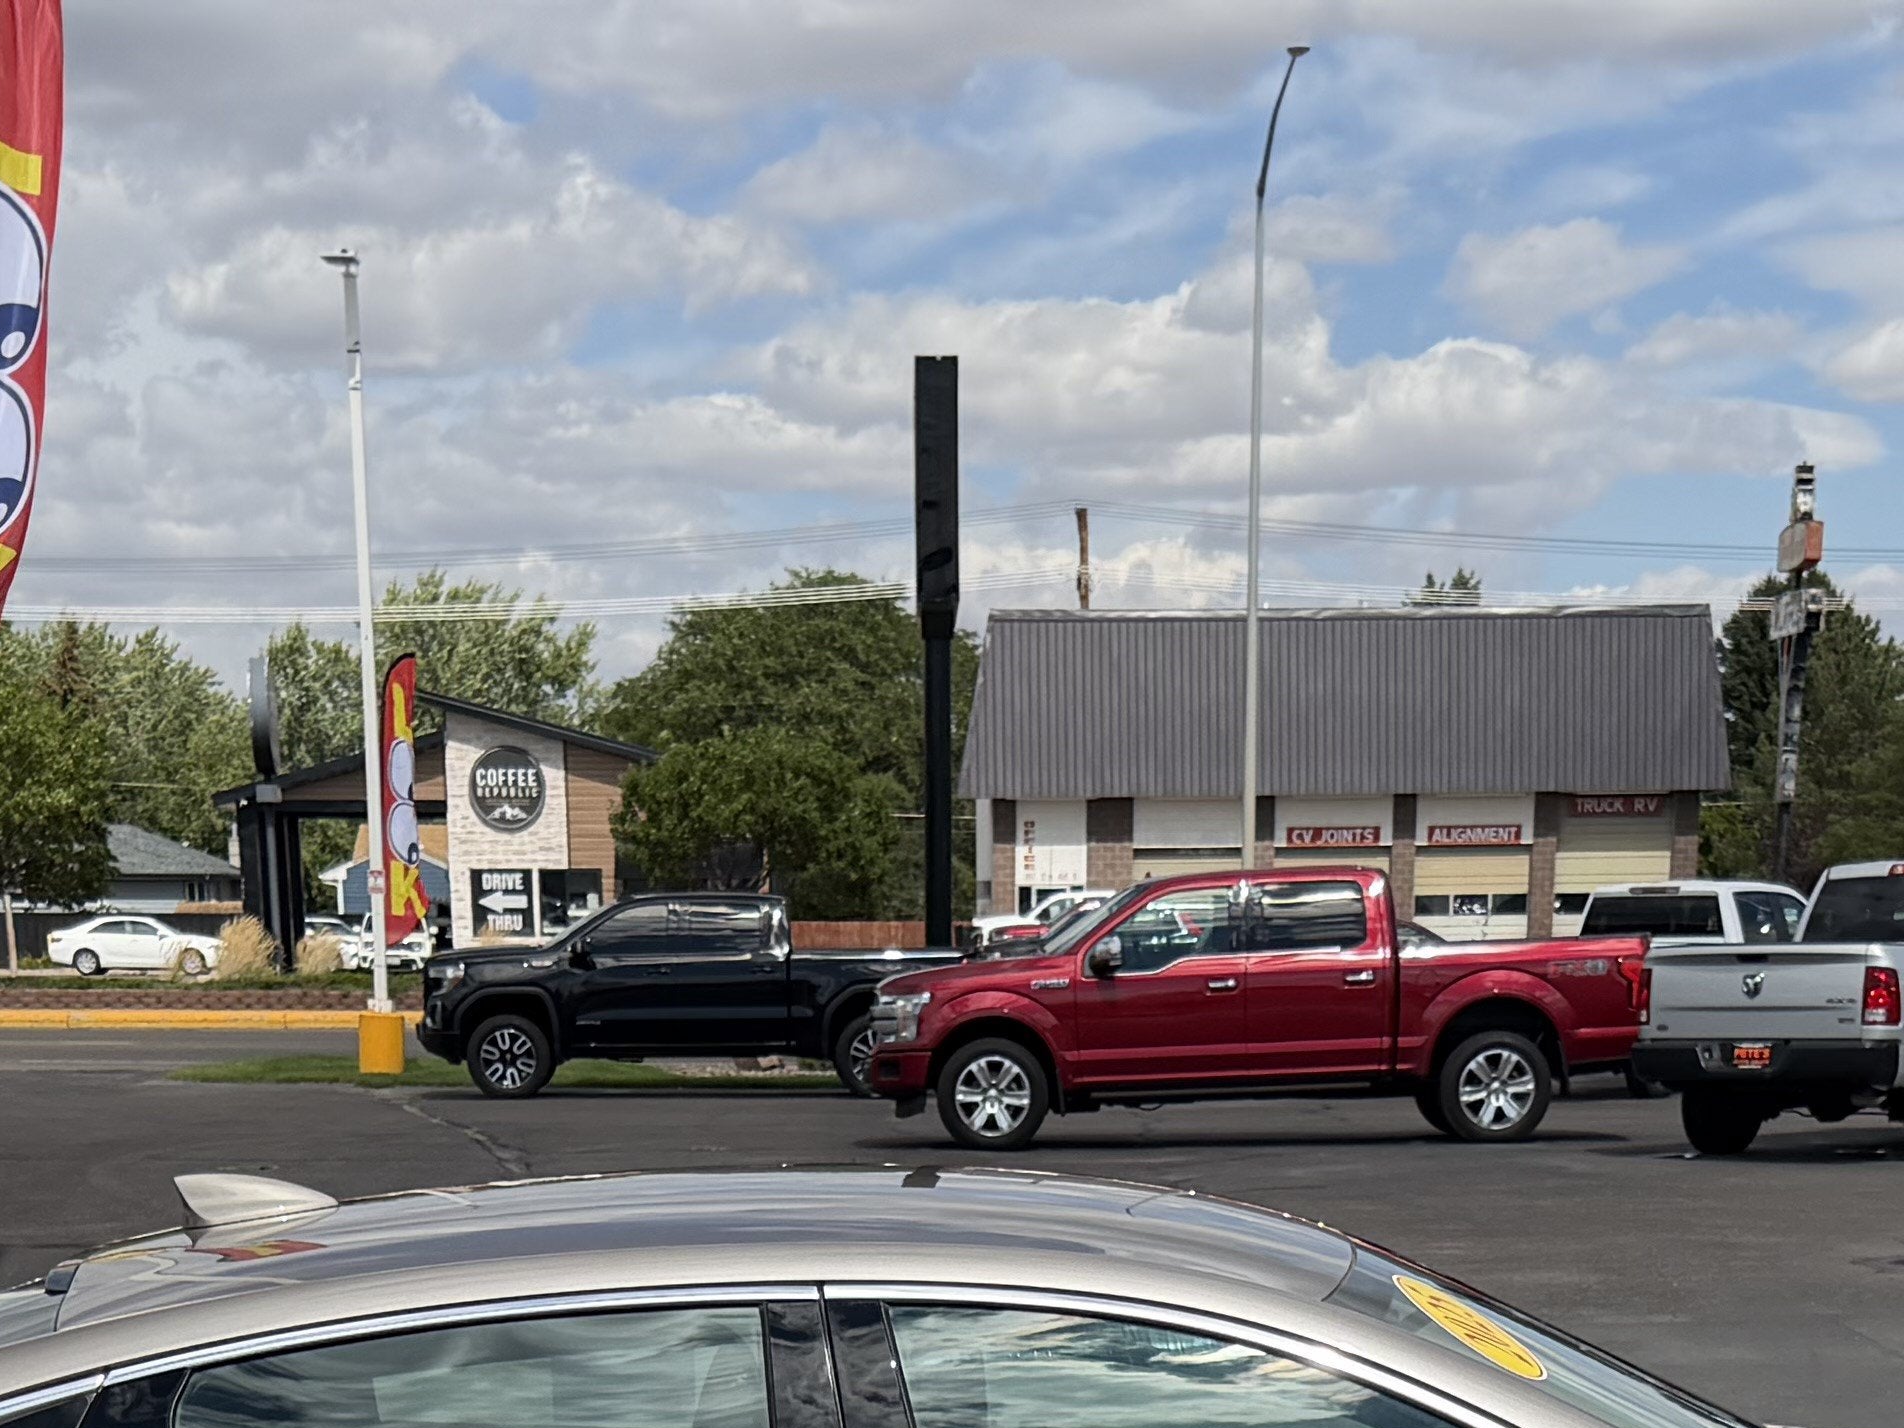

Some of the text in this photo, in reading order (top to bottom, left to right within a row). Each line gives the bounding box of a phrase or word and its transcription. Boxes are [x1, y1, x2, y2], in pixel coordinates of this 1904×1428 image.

[475, 768, 538, 787] COFFEE
[476, 786, 540, 798] REPUBLIC
[1573, 797, 1659, 814] TRUCK RV
[1291, 827, 1376, 845] CV JOINTS
[1430, 825, 1520, 844] ALIGNMENT
[481, 872, 525, 891] DRIVE
[487, 914, 524, 932] THRU
